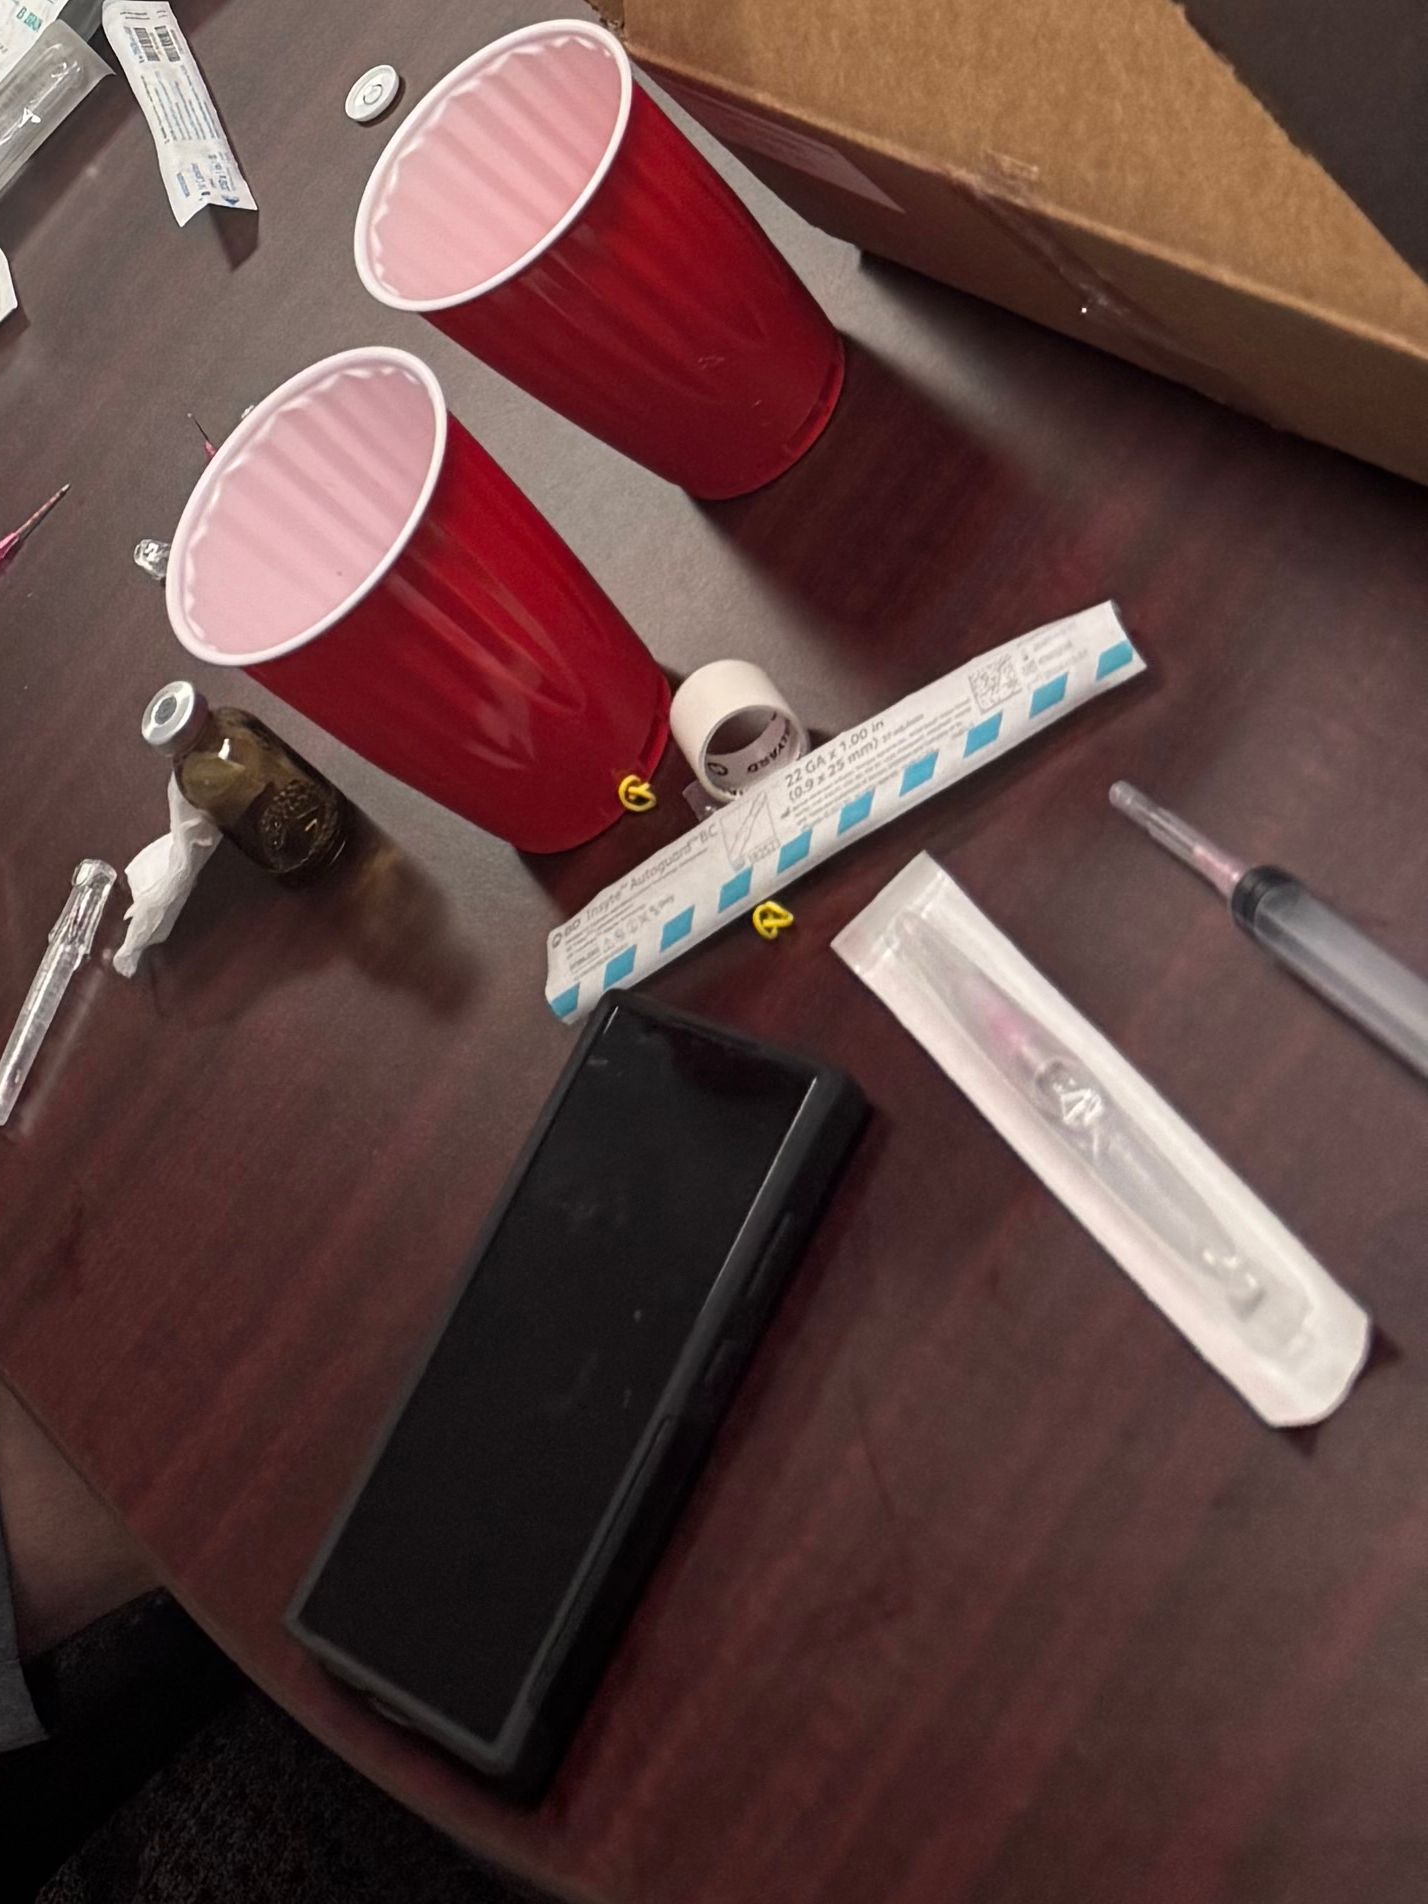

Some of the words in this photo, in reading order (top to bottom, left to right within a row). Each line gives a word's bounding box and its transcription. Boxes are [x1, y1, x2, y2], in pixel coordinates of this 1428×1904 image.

[781, 767, 805, 787] 22
[802, 753, 827, 774] GA
[837, 727, 870, 752] 1.00
[868, 717, 885, 733] in
[785, 777, 817, 802] (0.9
[824, 758, 846, 777] 25
[844, 736, 881, 764] mm)
[696, 822, 721, 844] BC
